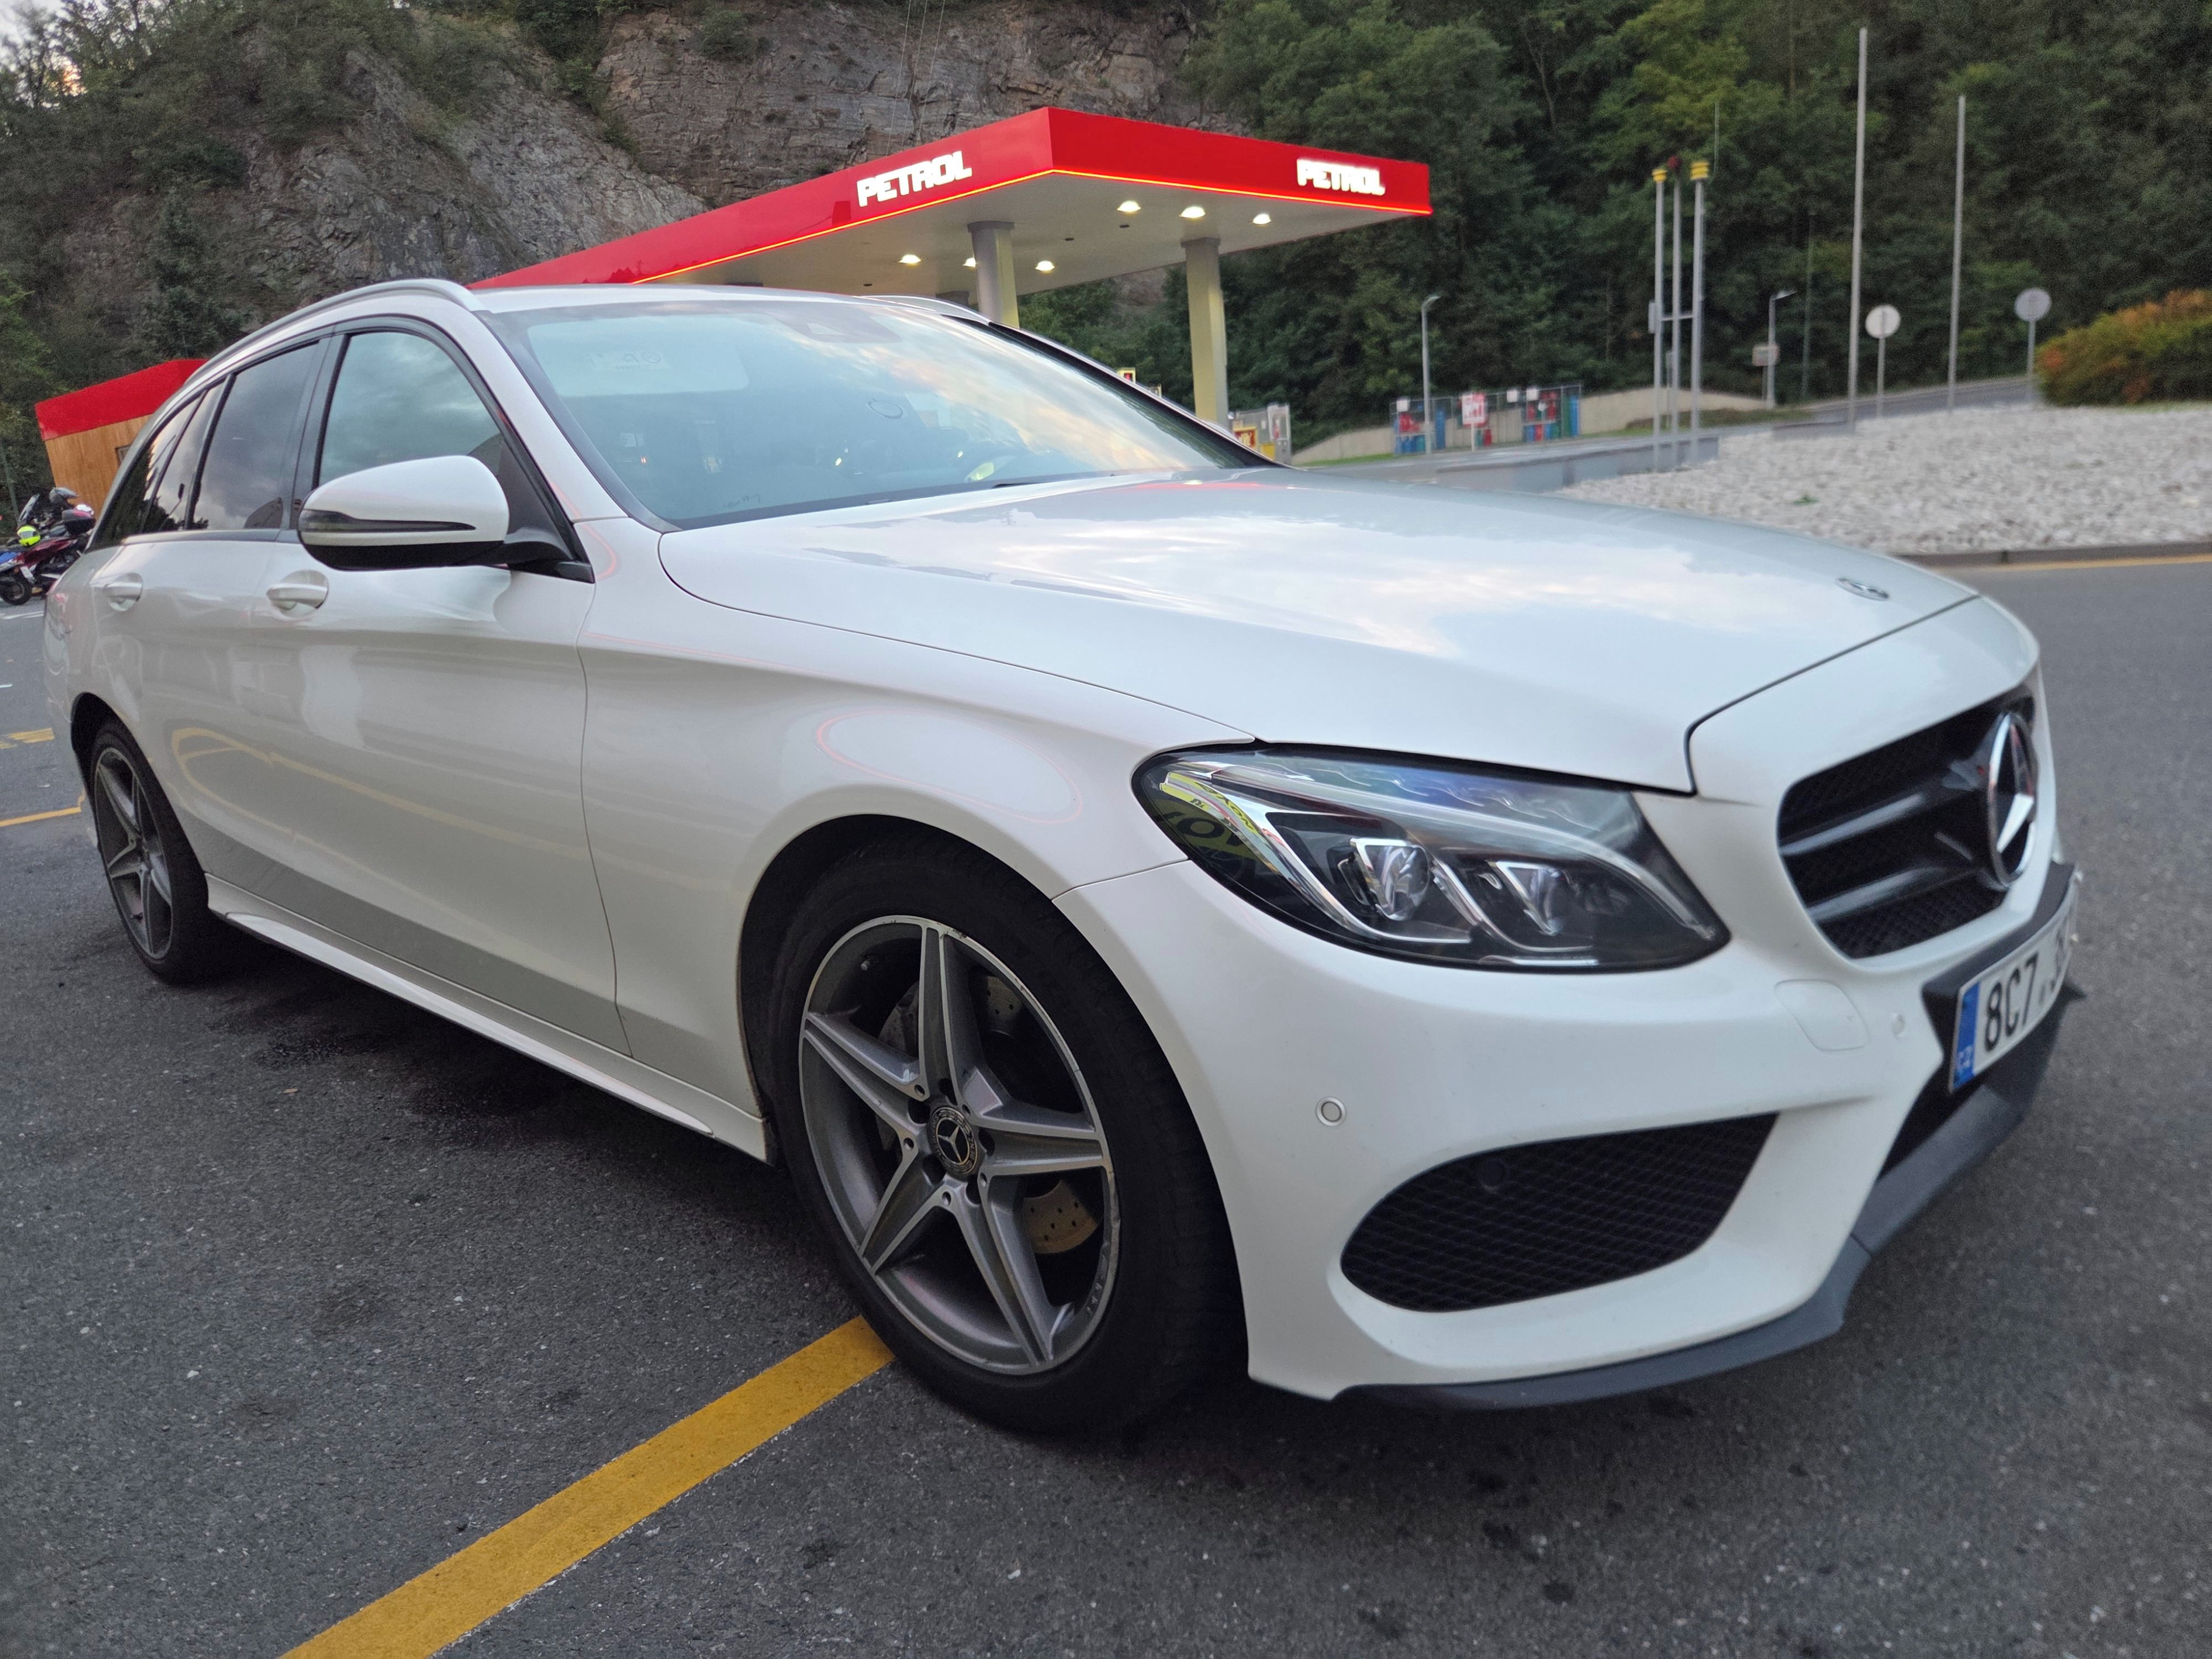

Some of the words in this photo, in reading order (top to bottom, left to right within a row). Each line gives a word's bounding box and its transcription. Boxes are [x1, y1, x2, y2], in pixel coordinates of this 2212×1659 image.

[857, 150, 972, 207] PETROL
[1296, 159, 1386, 196] PETROL
[1984, 952, 2039, 1052] 8C7
